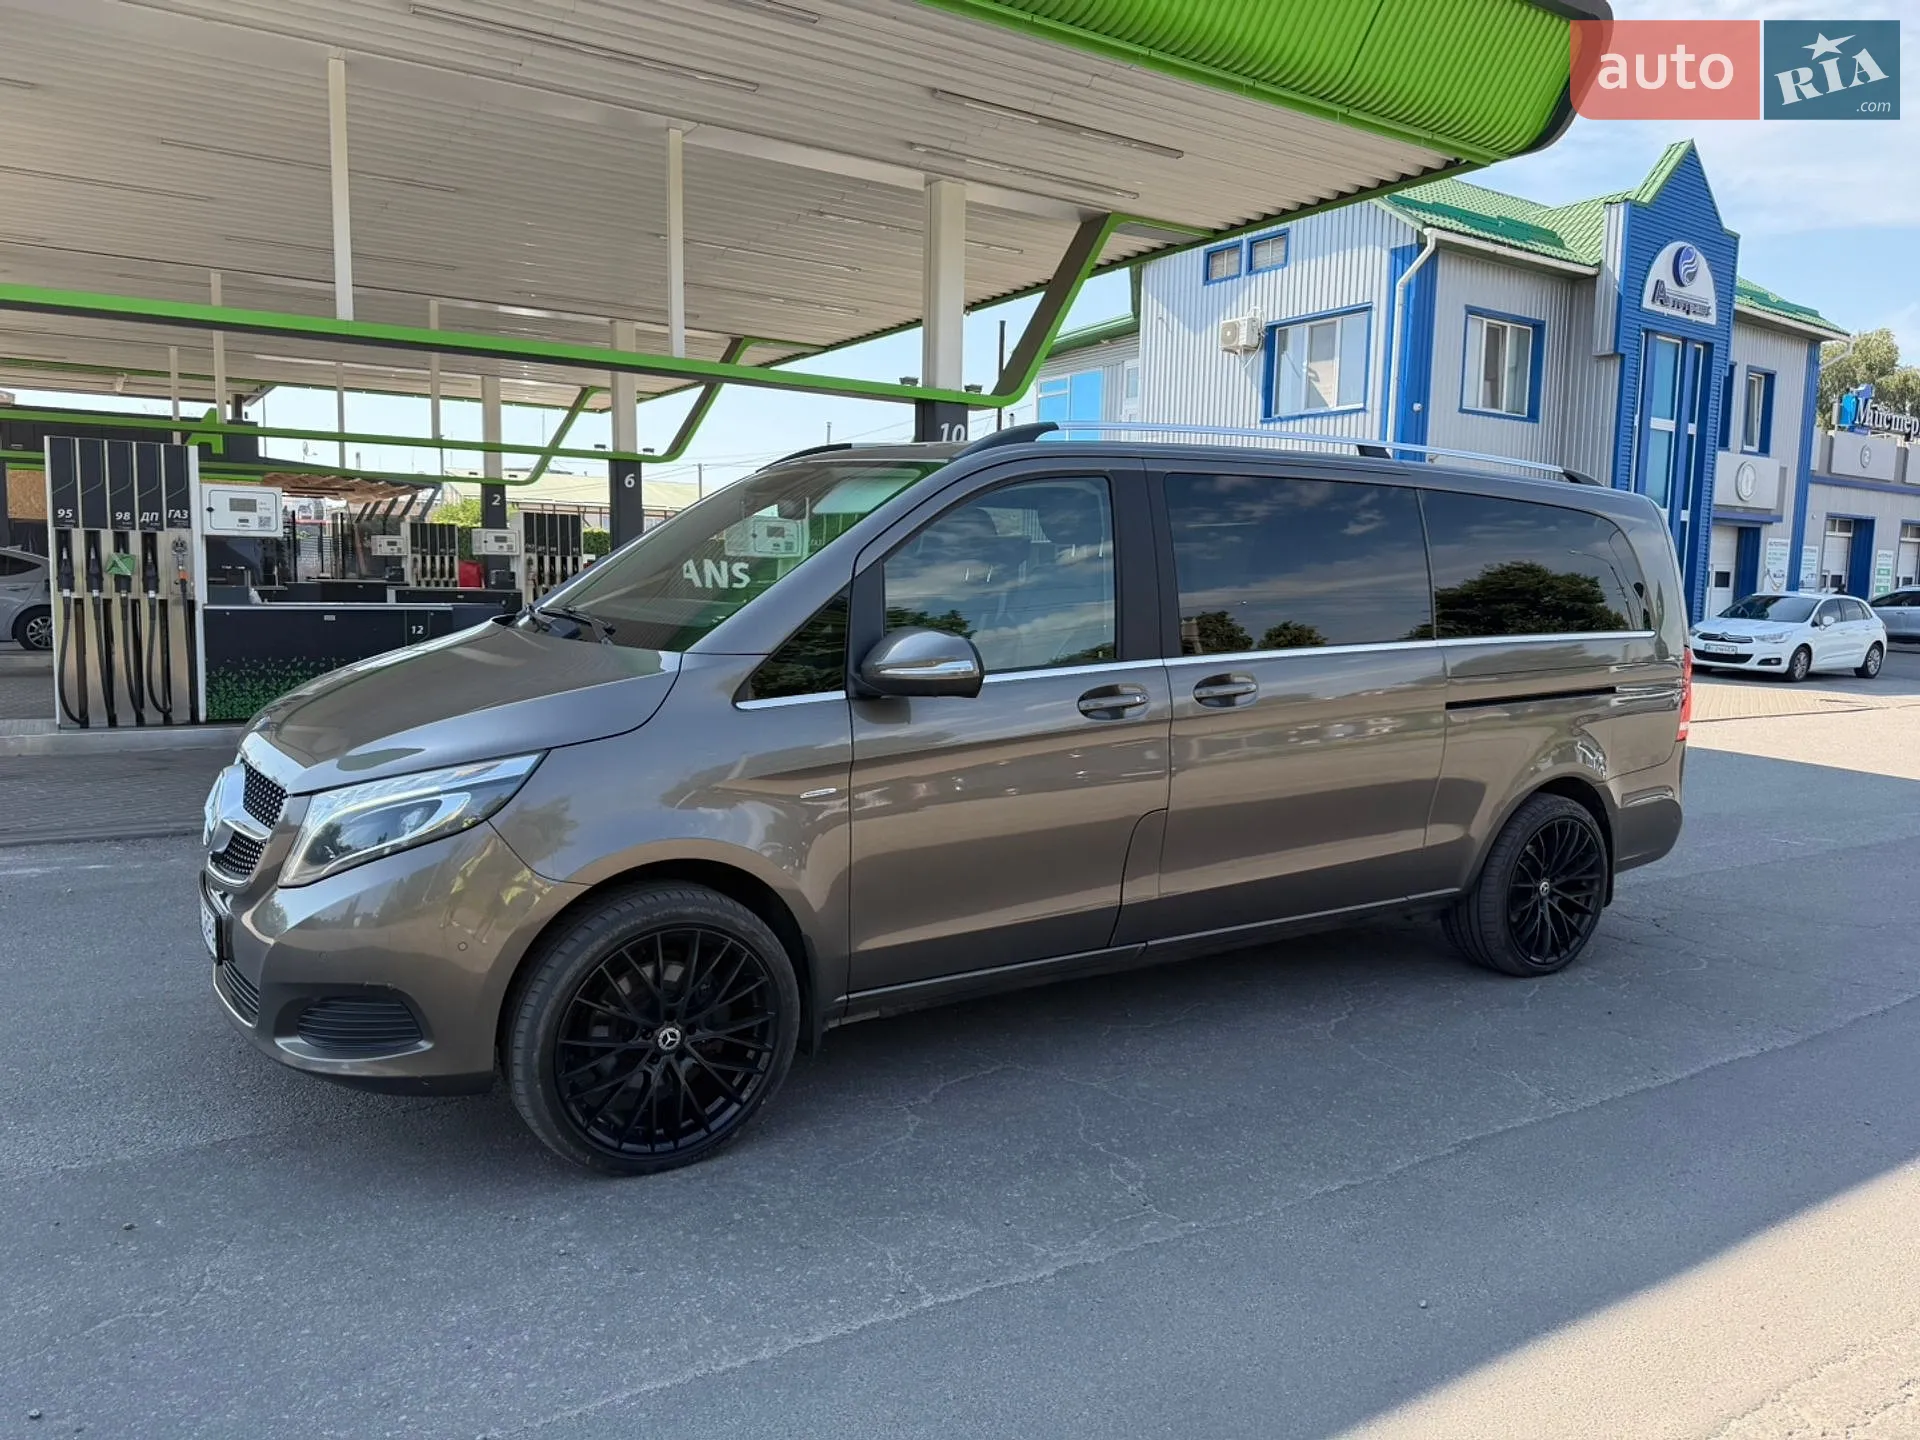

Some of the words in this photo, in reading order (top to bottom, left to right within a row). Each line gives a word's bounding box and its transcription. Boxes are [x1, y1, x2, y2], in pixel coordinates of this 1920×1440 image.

[940, 422, 966, 442] 10
[624, 474, 635, 488] 6
[491, 494, 501, 505] 2
[57, 508, 73, 519] 95
[115, 511, 131, 521] 98
[140, 511, 159, 523] ДП
[168, 509, 189, 519] ГАЗ
[411, 625, 424, 635] 12
